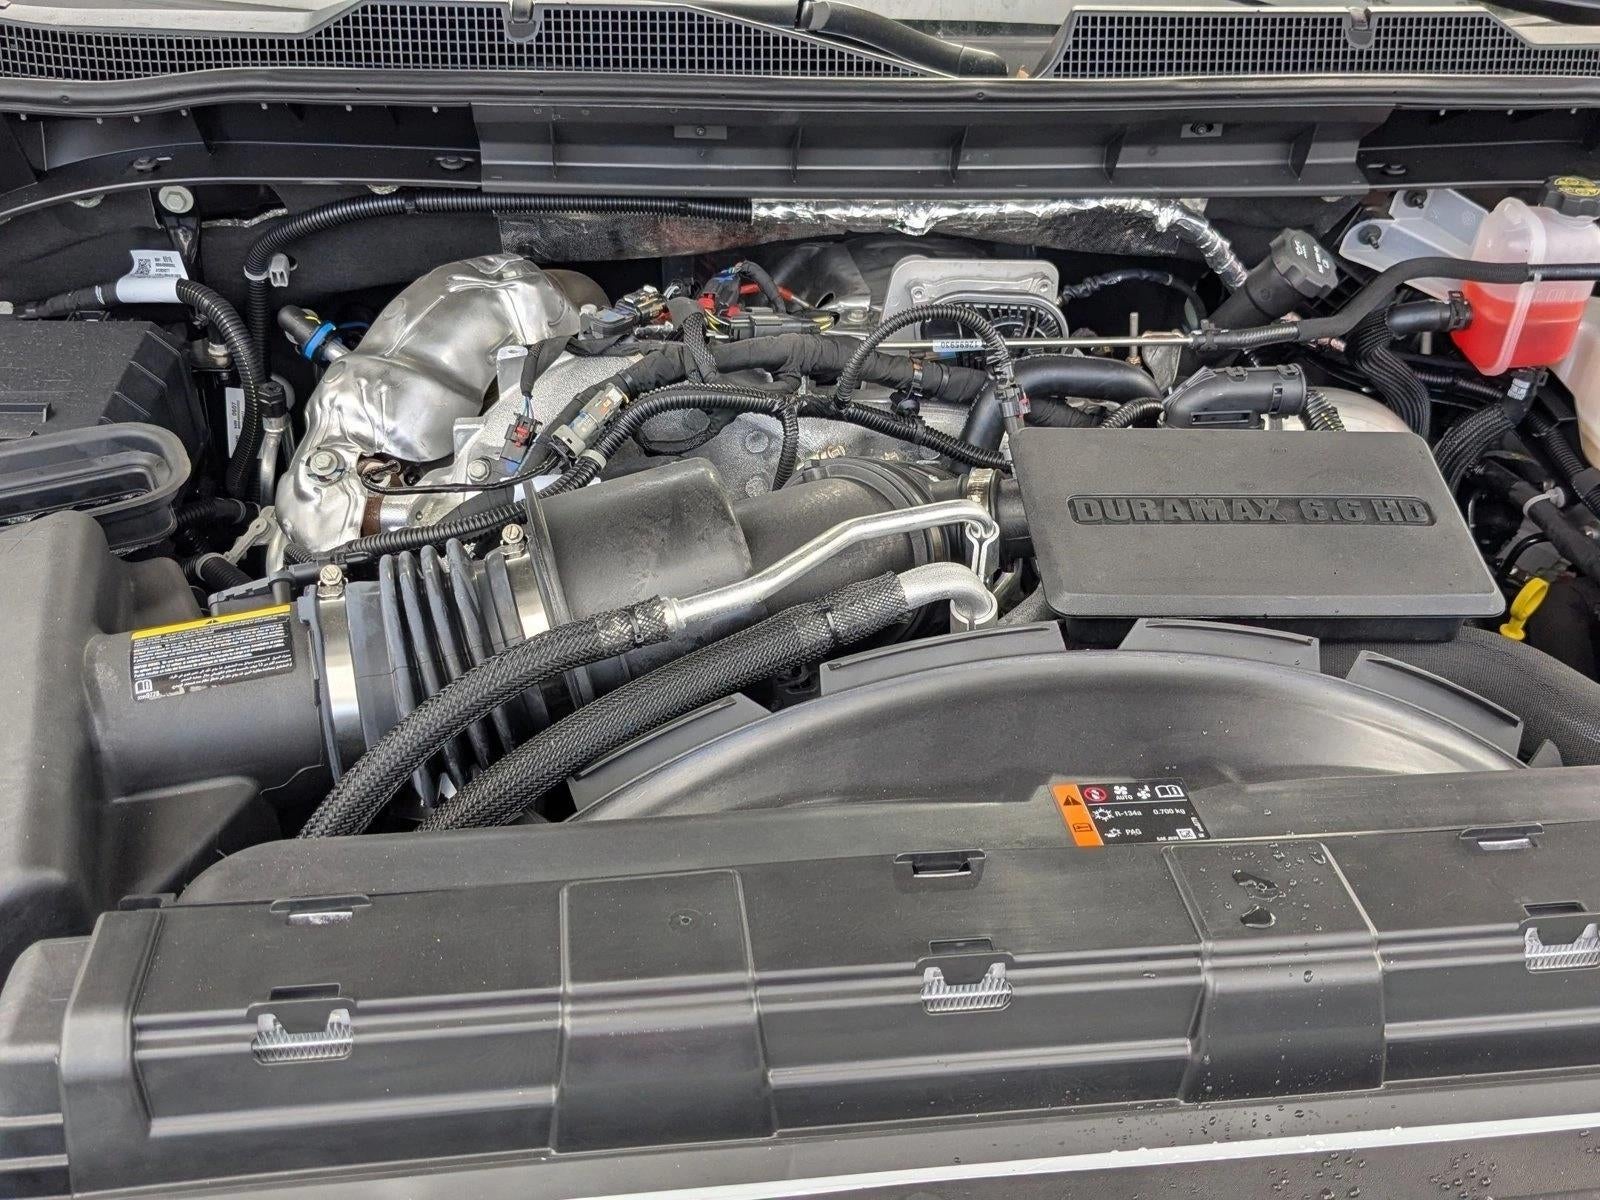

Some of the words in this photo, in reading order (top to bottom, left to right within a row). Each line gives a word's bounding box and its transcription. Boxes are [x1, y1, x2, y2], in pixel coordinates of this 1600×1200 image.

[1073, 498, 1288, 522] DURAMAX
[1299, 498, 1367, 523] 6.6
[1371, 499, 1430, 523] HD
[1114, 809, 1143, 817] R-134a
[1174, 807, 1186, 815] kg
[1125, 828, 1143, 836] PAG
